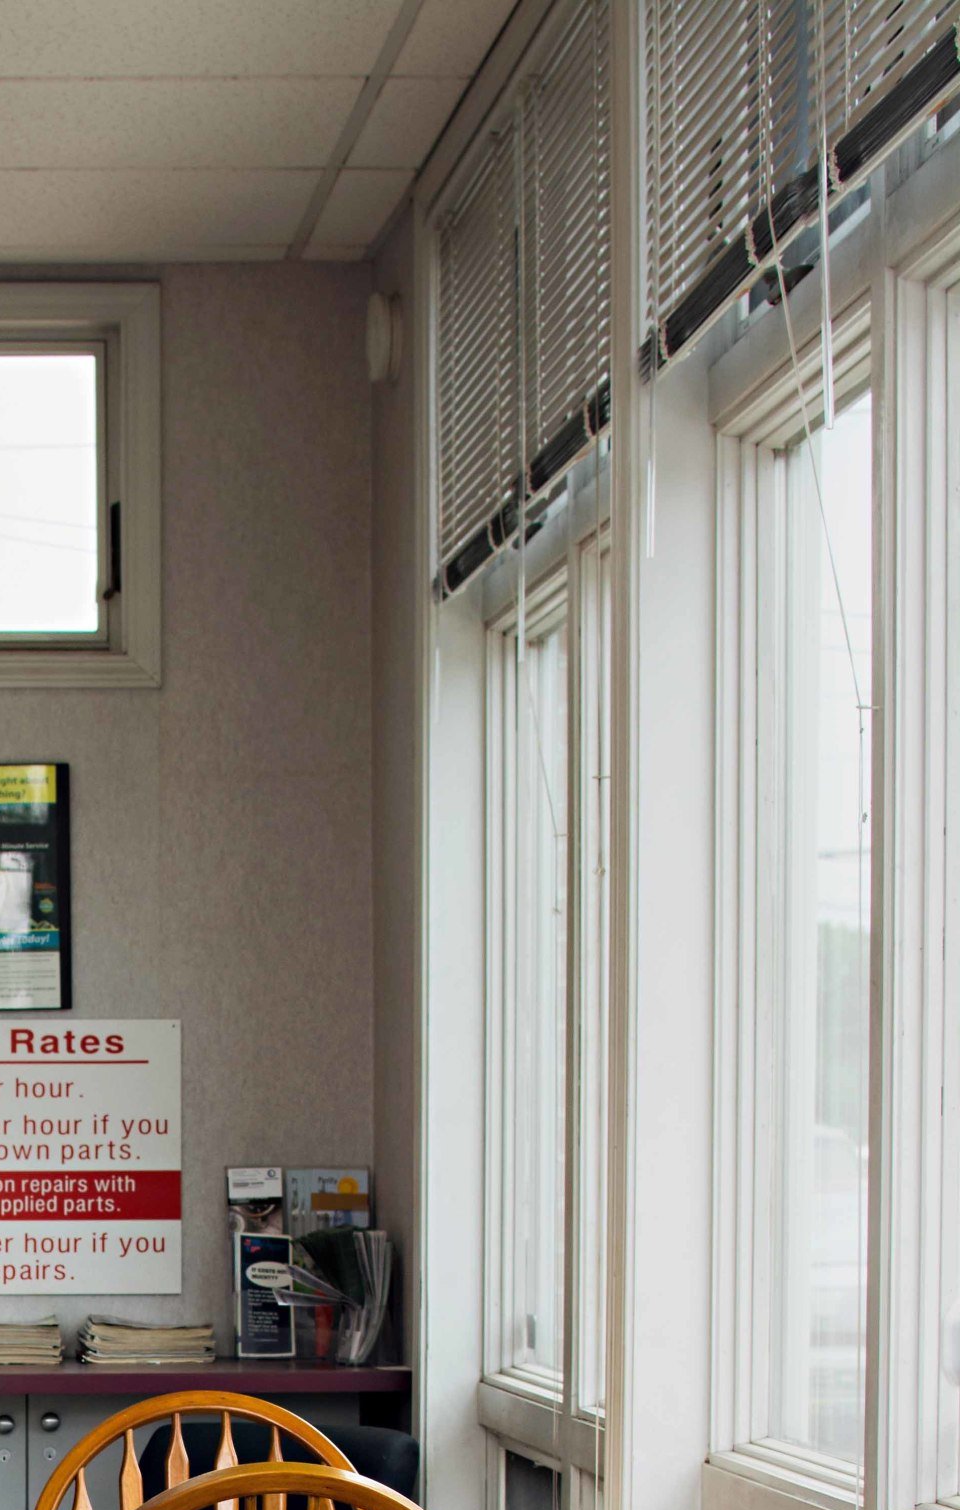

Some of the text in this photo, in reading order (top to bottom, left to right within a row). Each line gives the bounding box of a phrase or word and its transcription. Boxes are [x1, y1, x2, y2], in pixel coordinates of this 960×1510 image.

[10, 1028, 124, 1055] Rates
[15, 1079, 84, 1098] hour.
[23, 1115, 80, 1136] hour
[93, 1114, 109, 1135] if
[122, 1119, 169, 1139] you
[61, 1138, 141, 1163] parts.
[22, 1176, 87, 1196] repairs
[95, 1176, 135, 1192] with
[64, 1196, 120, 1215] parts.
[24, 1235, 80, 1254] hour
[92, 1233, 107, 1252] if
[120, 1236, 166, 1258] you
